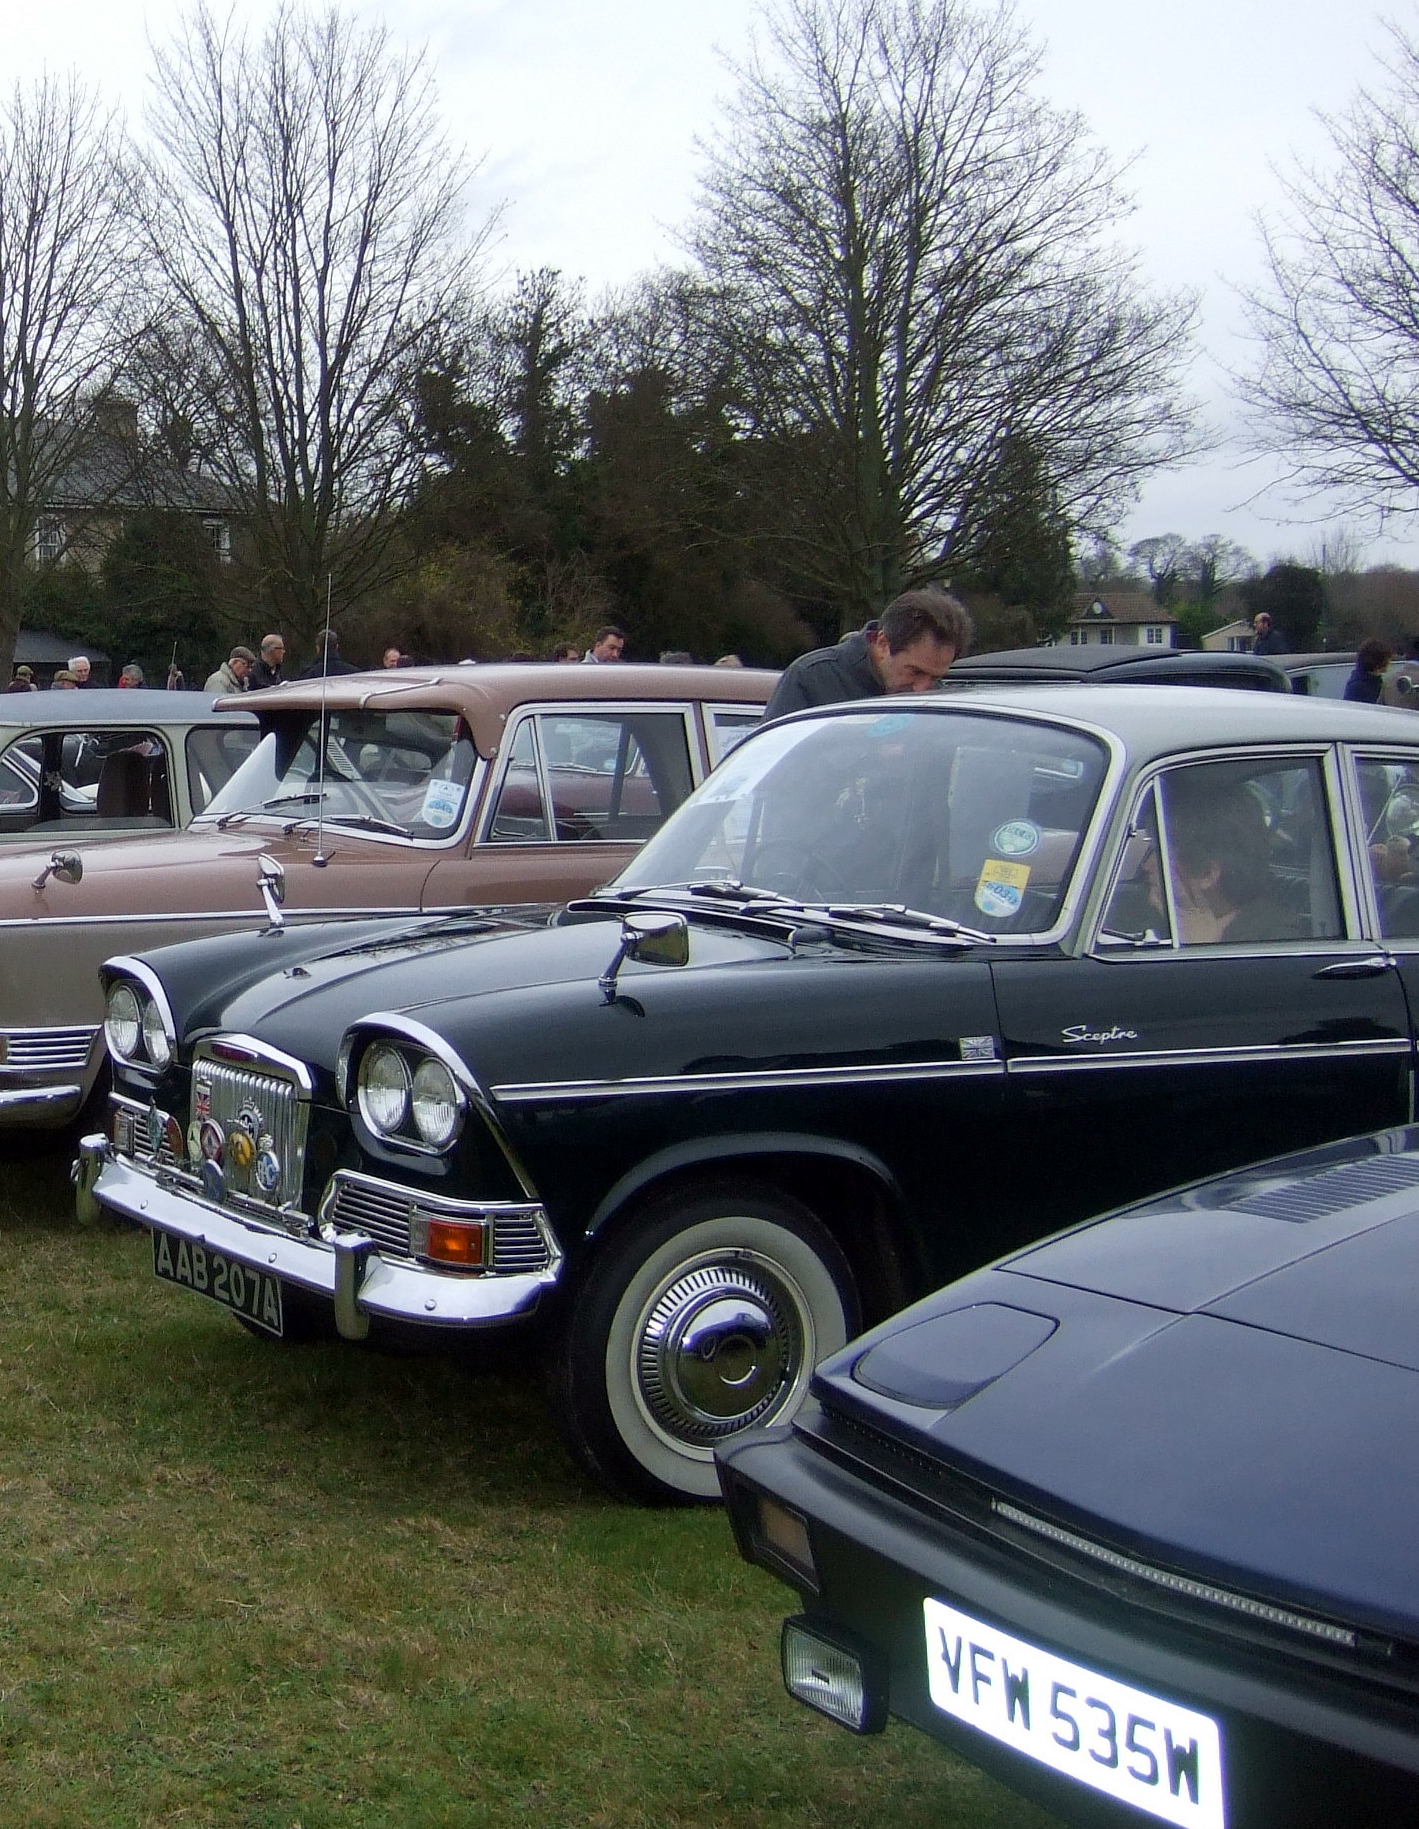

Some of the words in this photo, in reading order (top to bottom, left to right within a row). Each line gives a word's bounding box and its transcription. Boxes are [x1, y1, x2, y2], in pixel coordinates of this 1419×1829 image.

[1061, 1024, 1138, 1045] Sceptre
[157, 1232, 208, 1290] AAB
[213, 1254, 279, 1328] 207A
[938, 1626, 1031, 1731] VFW
[1049, 1680, 1199, 1805] 535W
